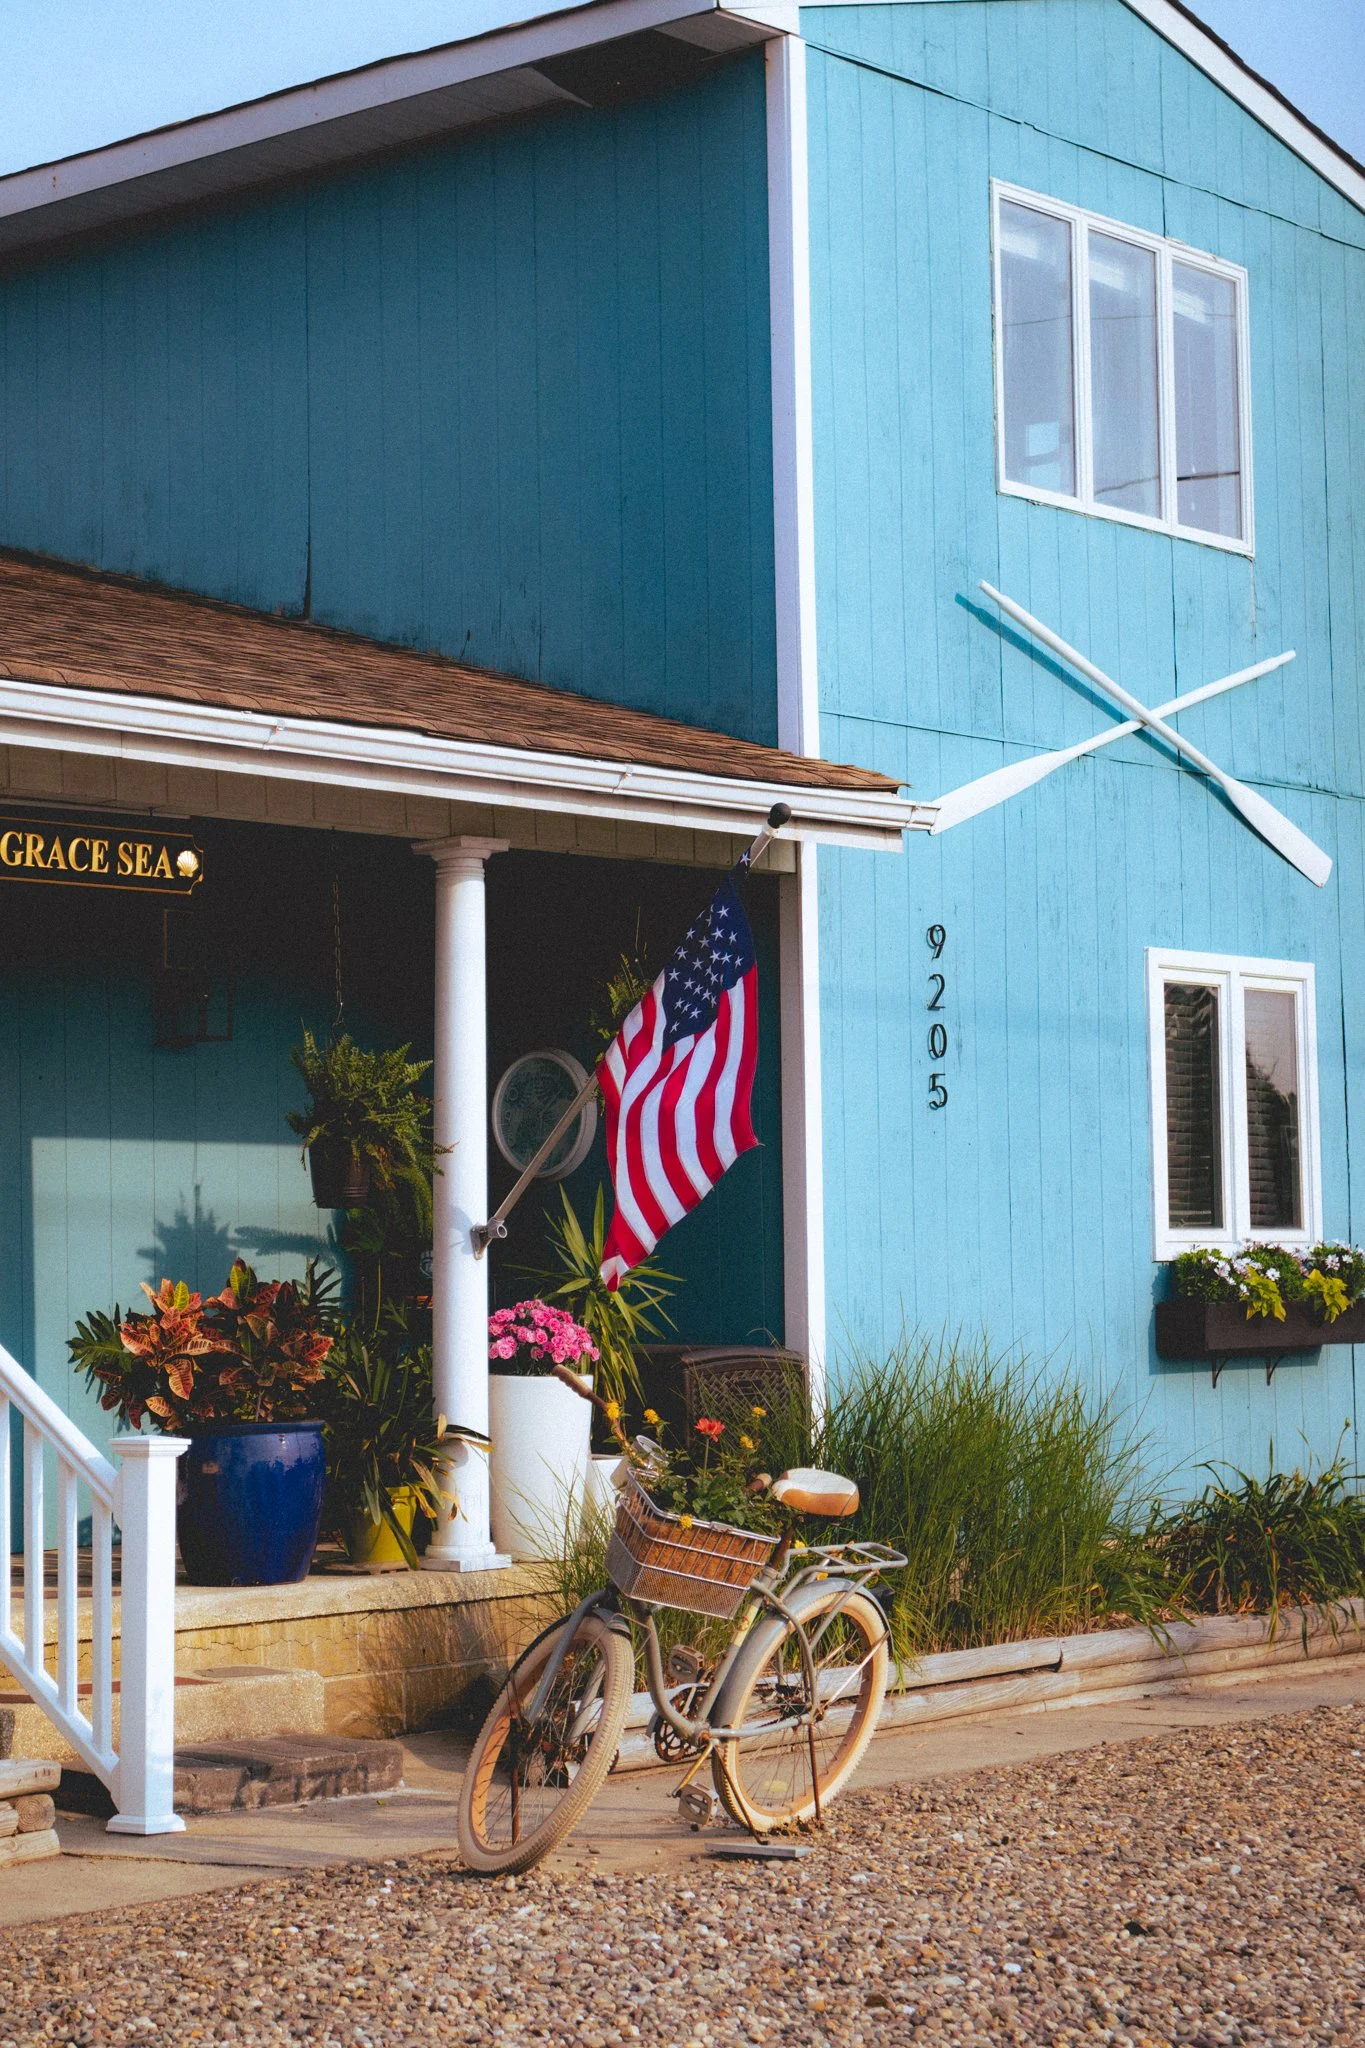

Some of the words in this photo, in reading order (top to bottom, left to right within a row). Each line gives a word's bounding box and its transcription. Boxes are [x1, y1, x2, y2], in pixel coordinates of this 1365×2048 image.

[0, 830, 109, 873] GRACE
[117, 841, 174, 879] SEA
[926, 924, 948, 1111] 9205
